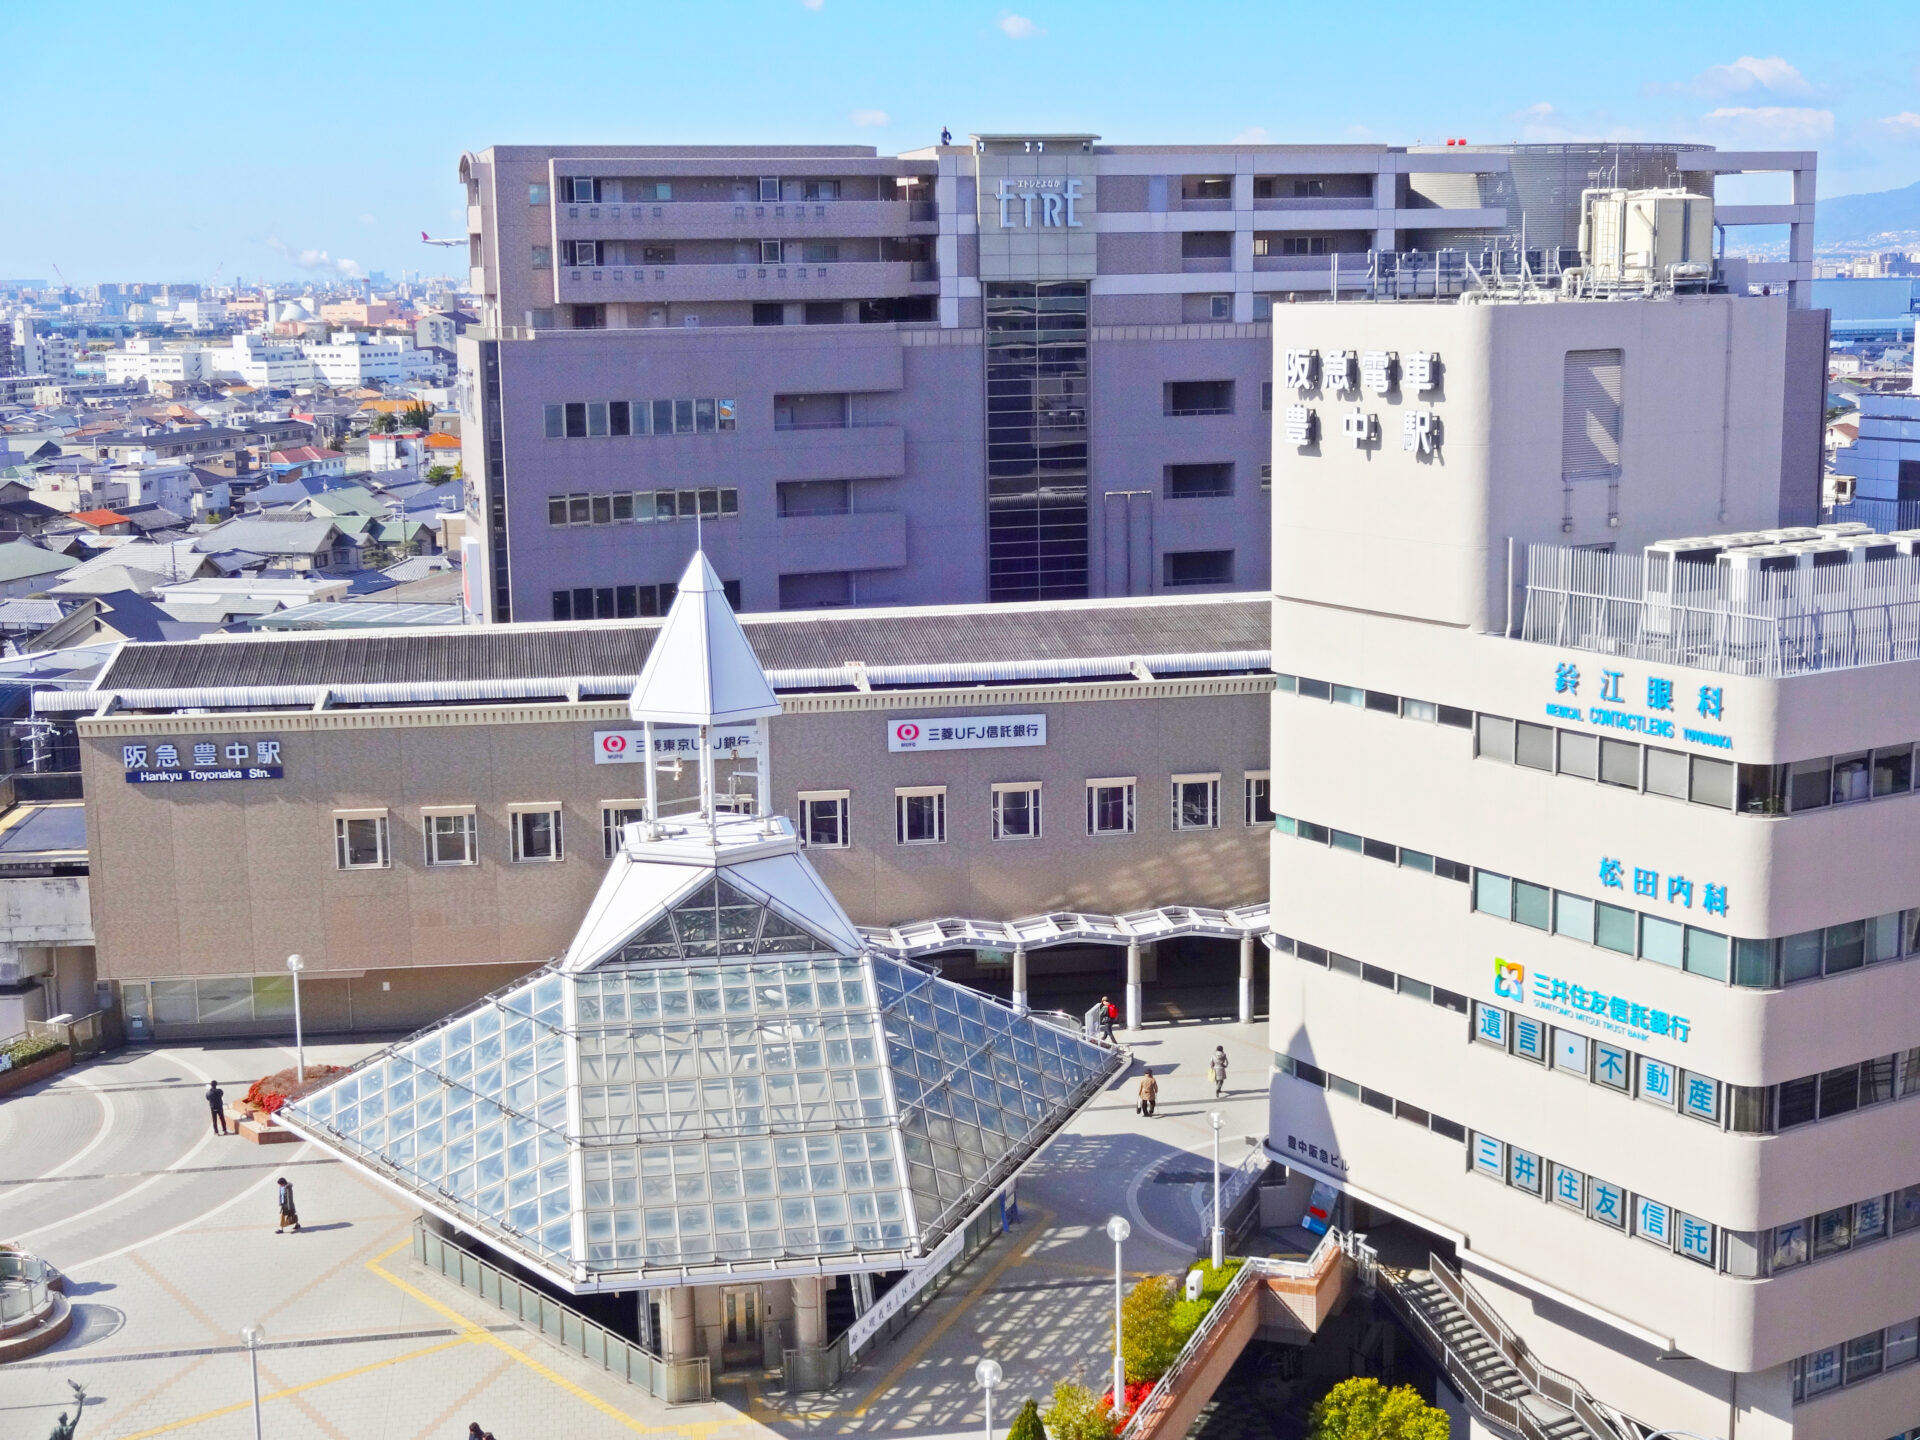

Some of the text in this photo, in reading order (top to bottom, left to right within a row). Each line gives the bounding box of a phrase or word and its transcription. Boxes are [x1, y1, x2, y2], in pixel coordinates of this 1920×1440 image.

[995, 179, 1083, 229] ETRE
[1018, 179, 1061, 189] エトレとよなか
[1285, 349, 1436, 394] 阪急電車
[1284, 402, 1435, 454] 豊中駅
[1555, 661, 1725, 720] 鈴江眼科
[123, 740, 283, 769] 阪急 豊中駅
[635, 735, 751, 753] 三菱東京UJ銀行
[928, 724, 1039, 741] 三菱UFJ信託銀行
[140, 768, 271, 783] Hankyu Toyonaka Stn.
[1598, 856, 1729, 917] 松田内科
[1533, 972, 1691, 1043] 三井住友信託銀行
[1533, 999, 1650, 1042] SUMITOMO MITSUI TRUST BANK
[1481, 1007, 1713, 1113] 遺言・不動産
[1287, 1134, 1351, 1172] 豊中阪急ビル
[1479, 1138, 1708, 1255] 三井住友信託
